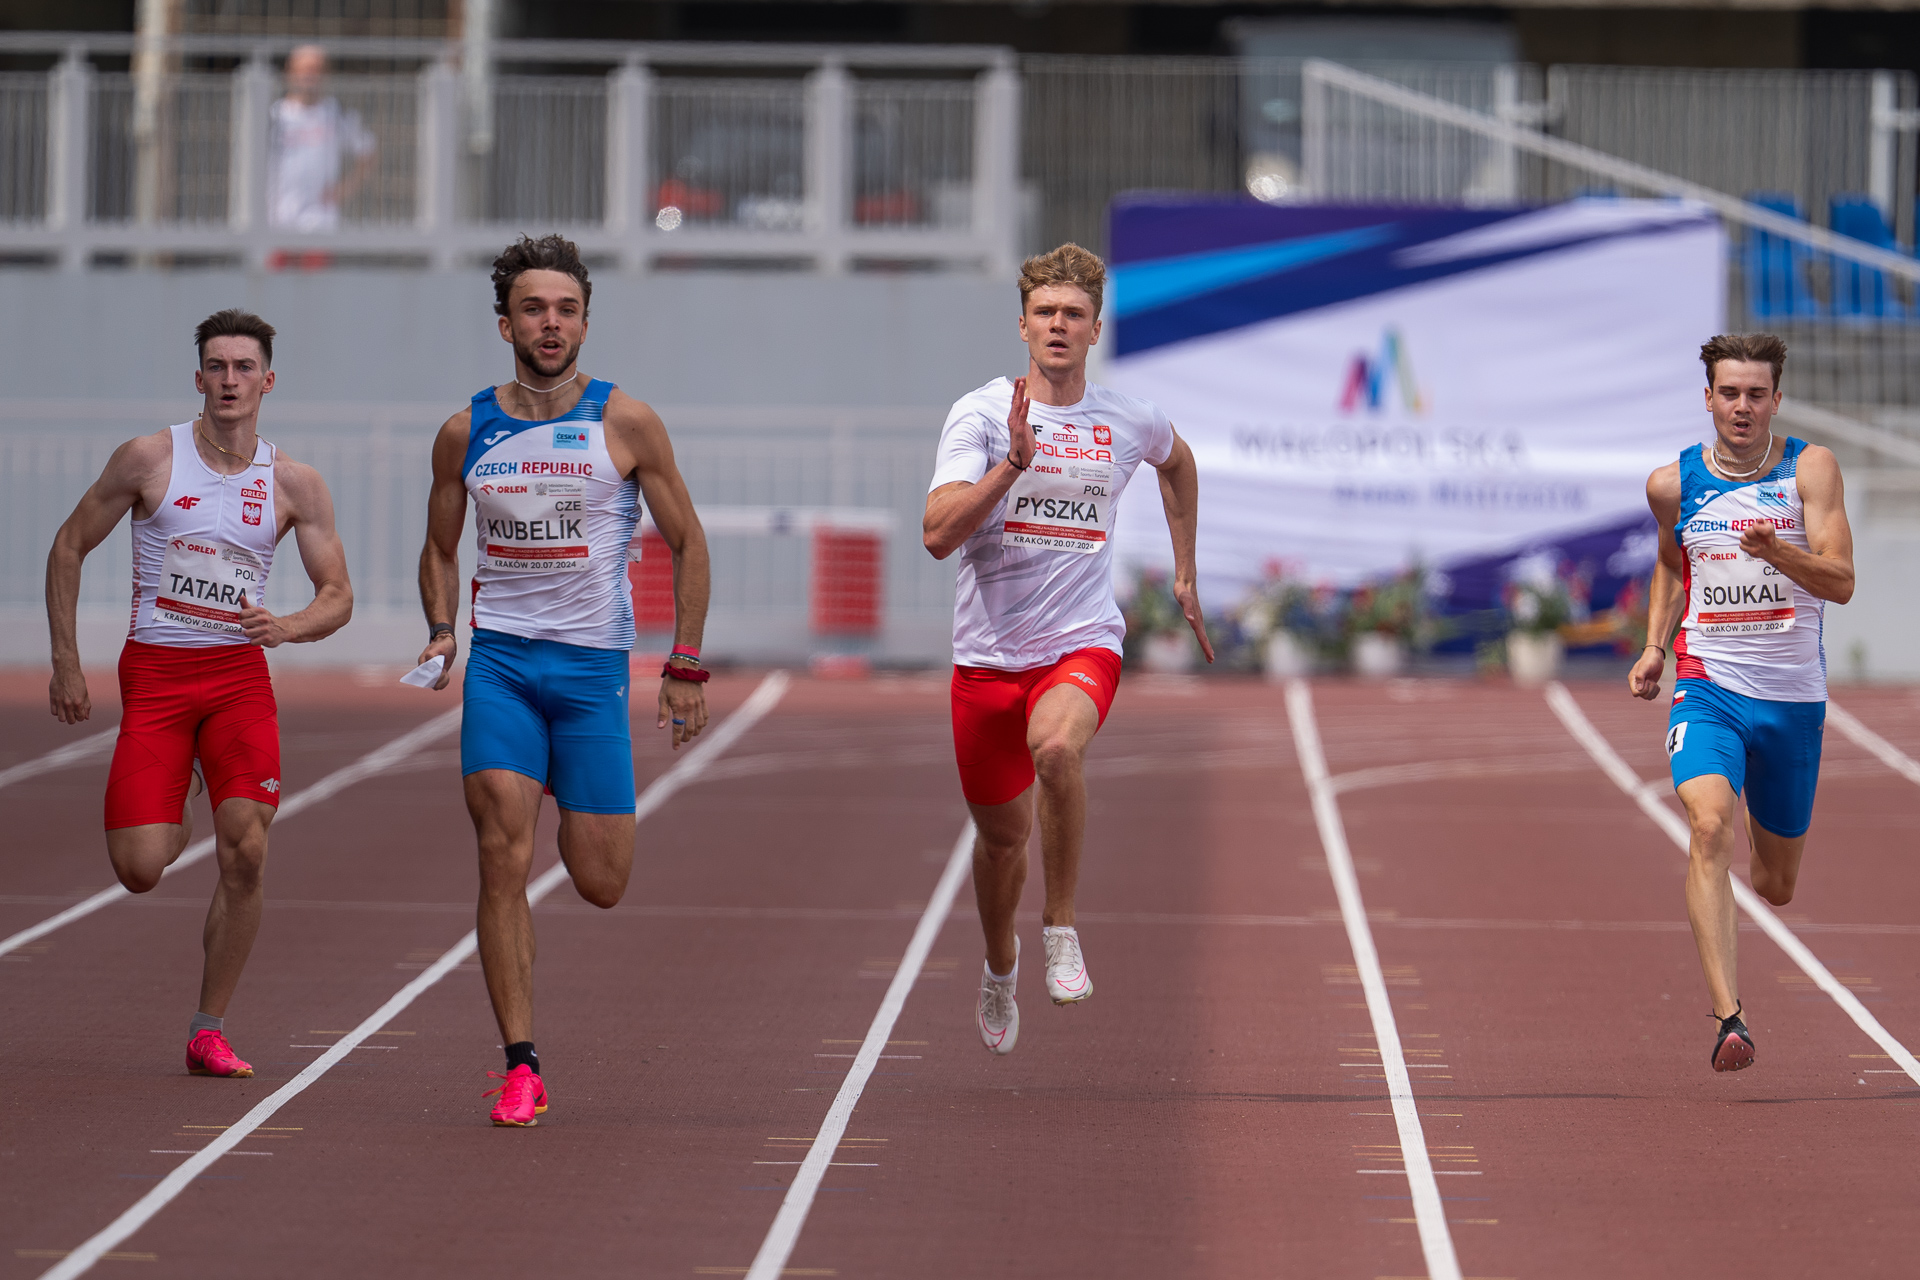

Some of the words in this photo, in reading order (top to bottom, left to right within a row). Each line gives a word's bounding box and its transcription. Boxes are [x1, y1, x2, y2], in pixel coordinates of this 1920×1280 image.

[1032, 425, 1043, 435] F
[1054, 434, 1078, 442] ORLEN
[476, 462, 517, 477] CZECH
[522, 462, 592, 476] REPUBLIC
[1035, 465, 1062, 474] ORLEN
[242, 490, 266, 499] ORLEN
[497, 486, 527, 494] ORLEN
[1084, 485, 1108, 496] POL
[174, 496, 201, 510] 4F
[555, 501, 581, 511] CZE
[1015, 496, 1098, 523] PYSZKA
[487, 514, 583, 540] KUBELÍK
[1690, 520, 1728, 532] CZECH
[1732, 518, 1795, 531] REPLIC
[1014, 536, 1051, 545] KRAKÓW
[1054, 539, 1094, 549] 20.07.2024
[188, 544, 216, 556] ORLEN
[495, 559, 528, 568] KRAKÓW
[235, 568, 256, 581] POL
[1763, 566, 1782, 576] CZ
[170, 573, 247, 605] TATARA
[1704, 584, 1786, 605] SOUKAL
[164, 612, 200, 626] KRAKÓW
[202, 620, 242, 633] 20.07.2024
[1706, 624, 1738, 632] KRAKÓW
[1741, 622, 1784, 632] 20.07.2024
[1069, 672, 1097, 686] 4F
[1668, 726, 1678, 753] 4
